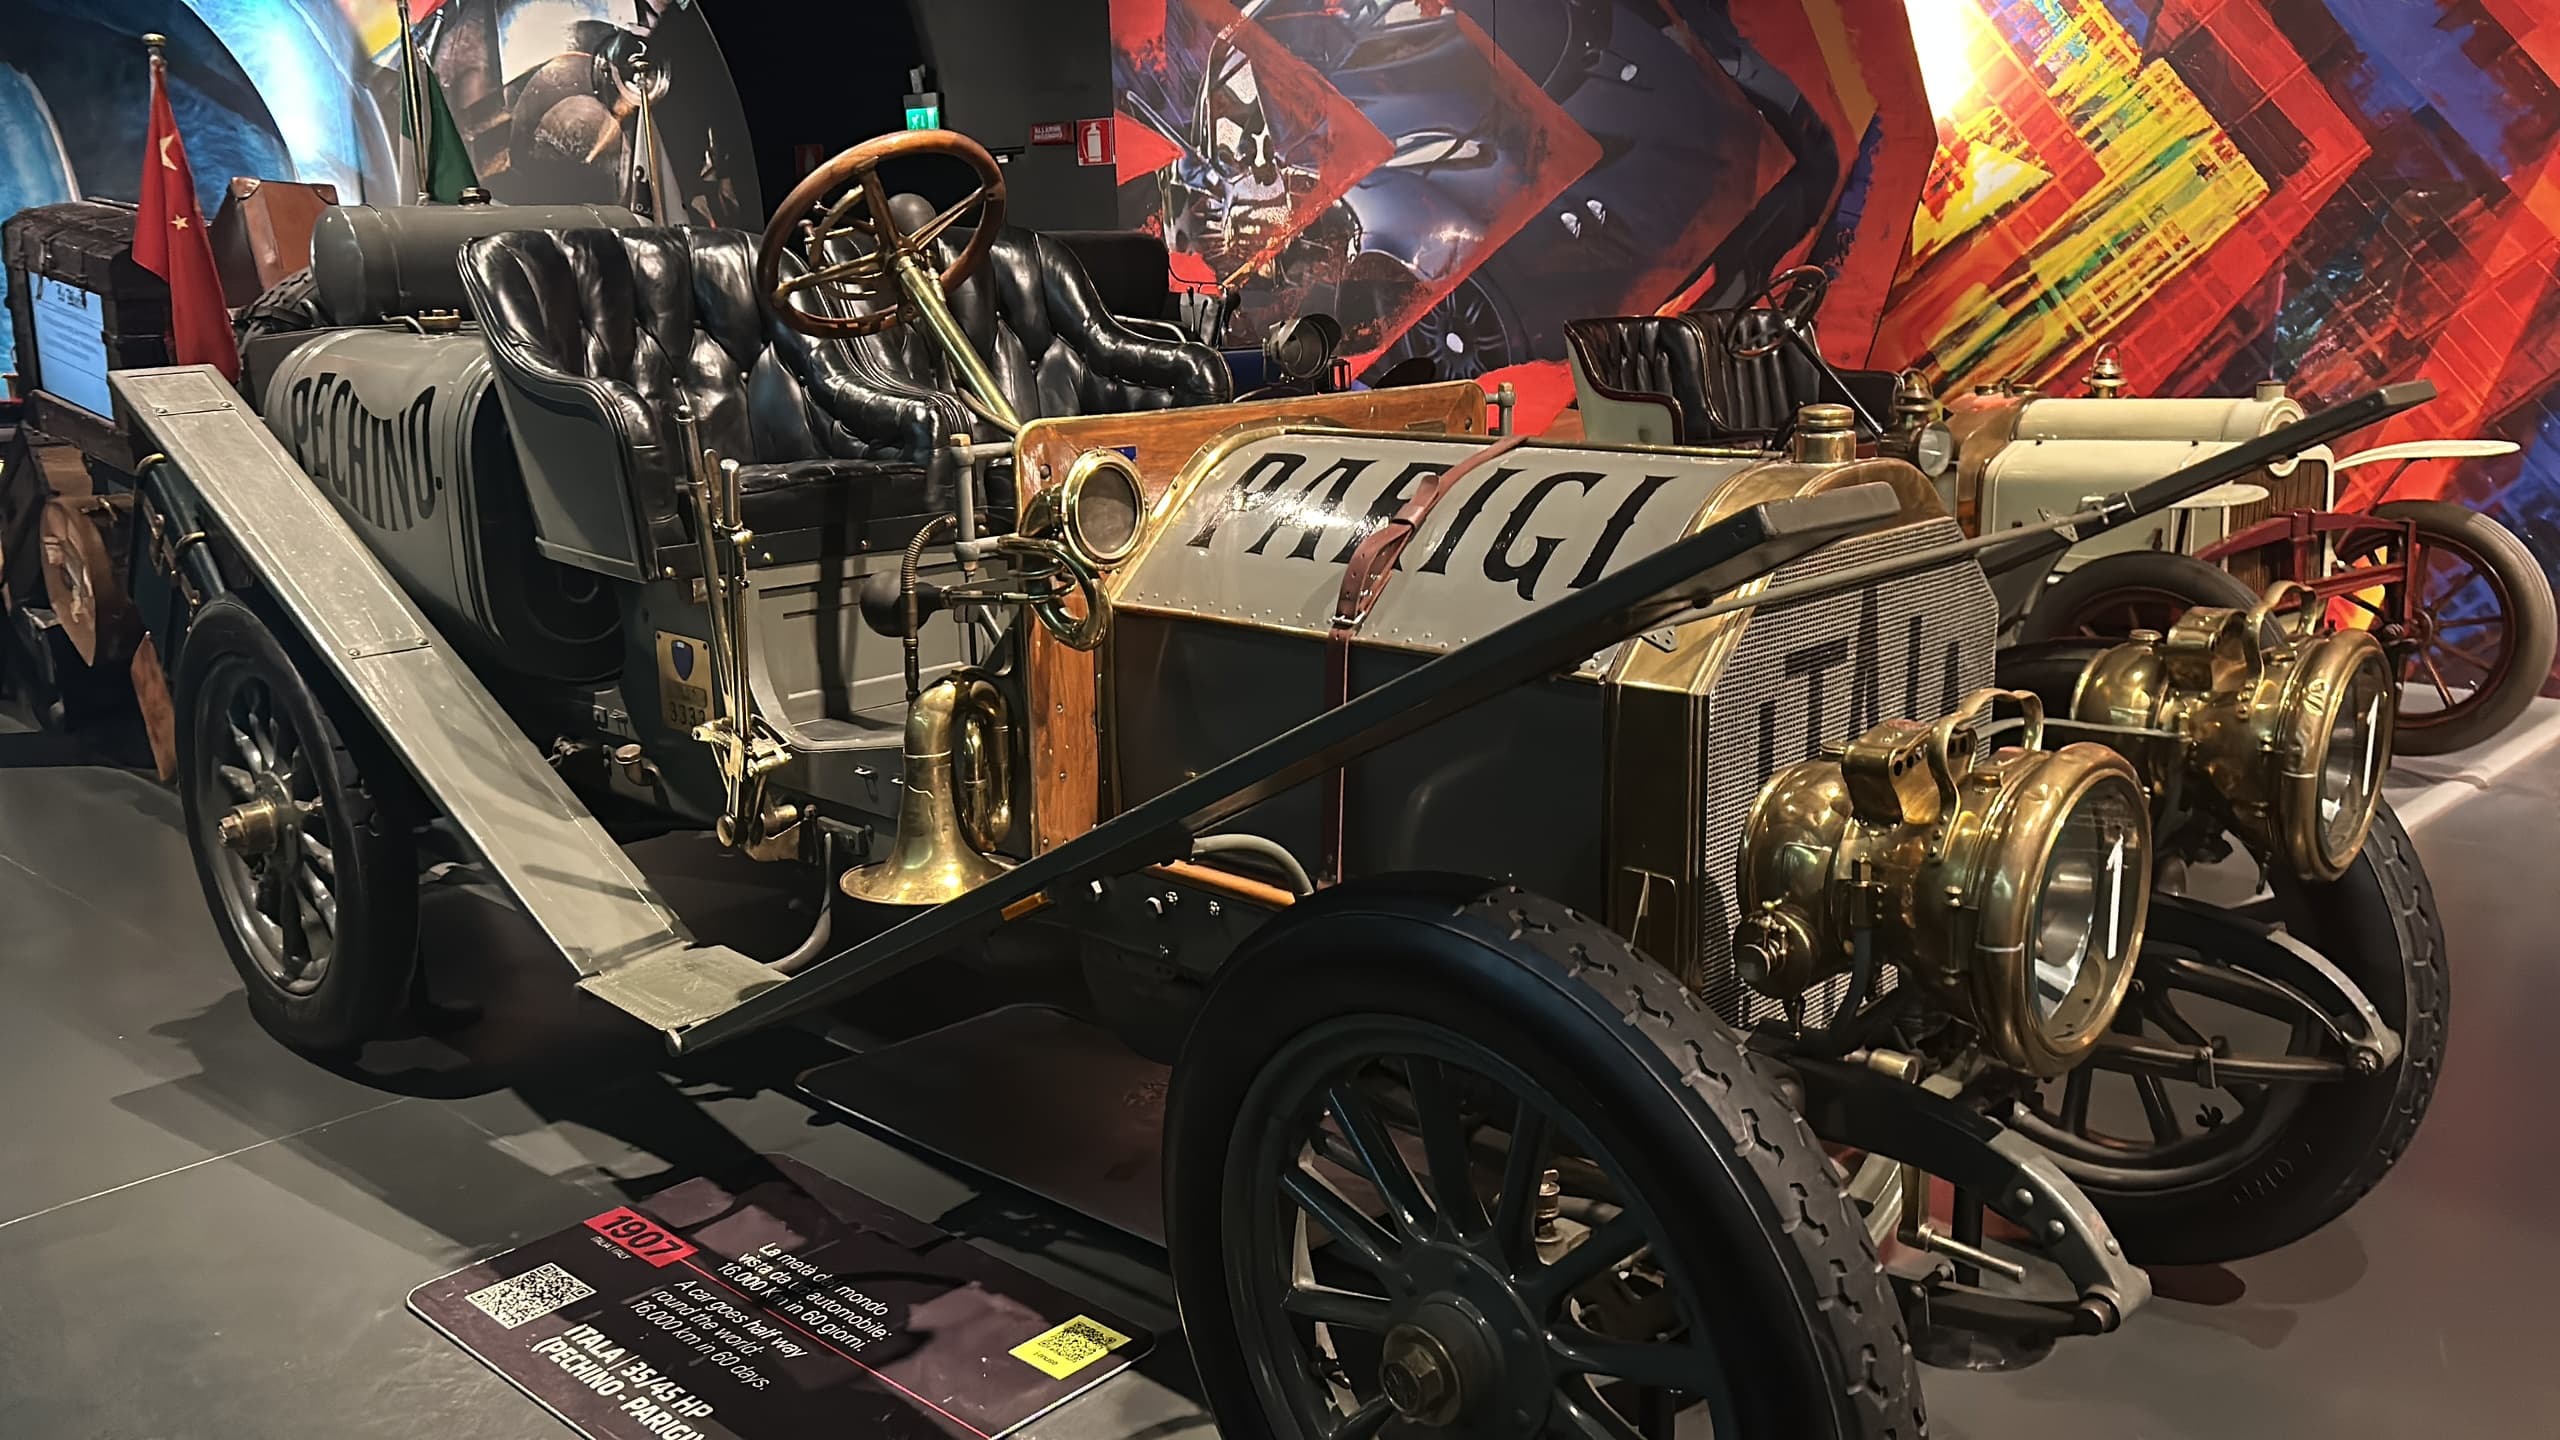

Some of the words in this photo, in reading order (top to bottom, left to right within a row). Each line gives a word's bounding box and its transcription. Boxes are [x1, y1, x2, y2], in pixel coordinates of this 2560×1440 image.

[1186, 452, 1678, 601] PARIGI
[600, 1216, 684, 1256] 1907
[738, 1253, 773, 1275] vista
[769, 1271, 792, 1285] da
[717, 1262, 768, 1291] 16.000
[785, 1300, 804, 1314] in
[801, 1310, 828, 1326] 60
[817, 1323, 871, 1352] giorni.
[759, 1242, 782, 1257] La
[778, 1254, 819, 1277] metà
[834, 1285, 888, 1316] mondo
[630, 1300, 683, 1331] 16,000
[672, 1326, 702, 1346] km
[694, 1341, 716, 1355] in
[710, 1351, 741, 1367] 60
[730, 1363, 771, 1391] days.
[651, 1290, 701, 1316] round
[689, 1312, 719, 1330] the
[714, 1327, 764, 1357] world:
[673, 1280, 698, 1291] A
[688, 1287, 717, 1302] car
[705, 1301, 749, 1324] goes
[742, 1319, 783, 1340] half
[774, 1336, 808, 1358] way
[530, 1336, 626, 1397] (PECHINO
[563, 1323, 627, 1364] ITALA
[621, 1361, 687, 1402] 35/45
[670, 1395, 714, 1418] HP
